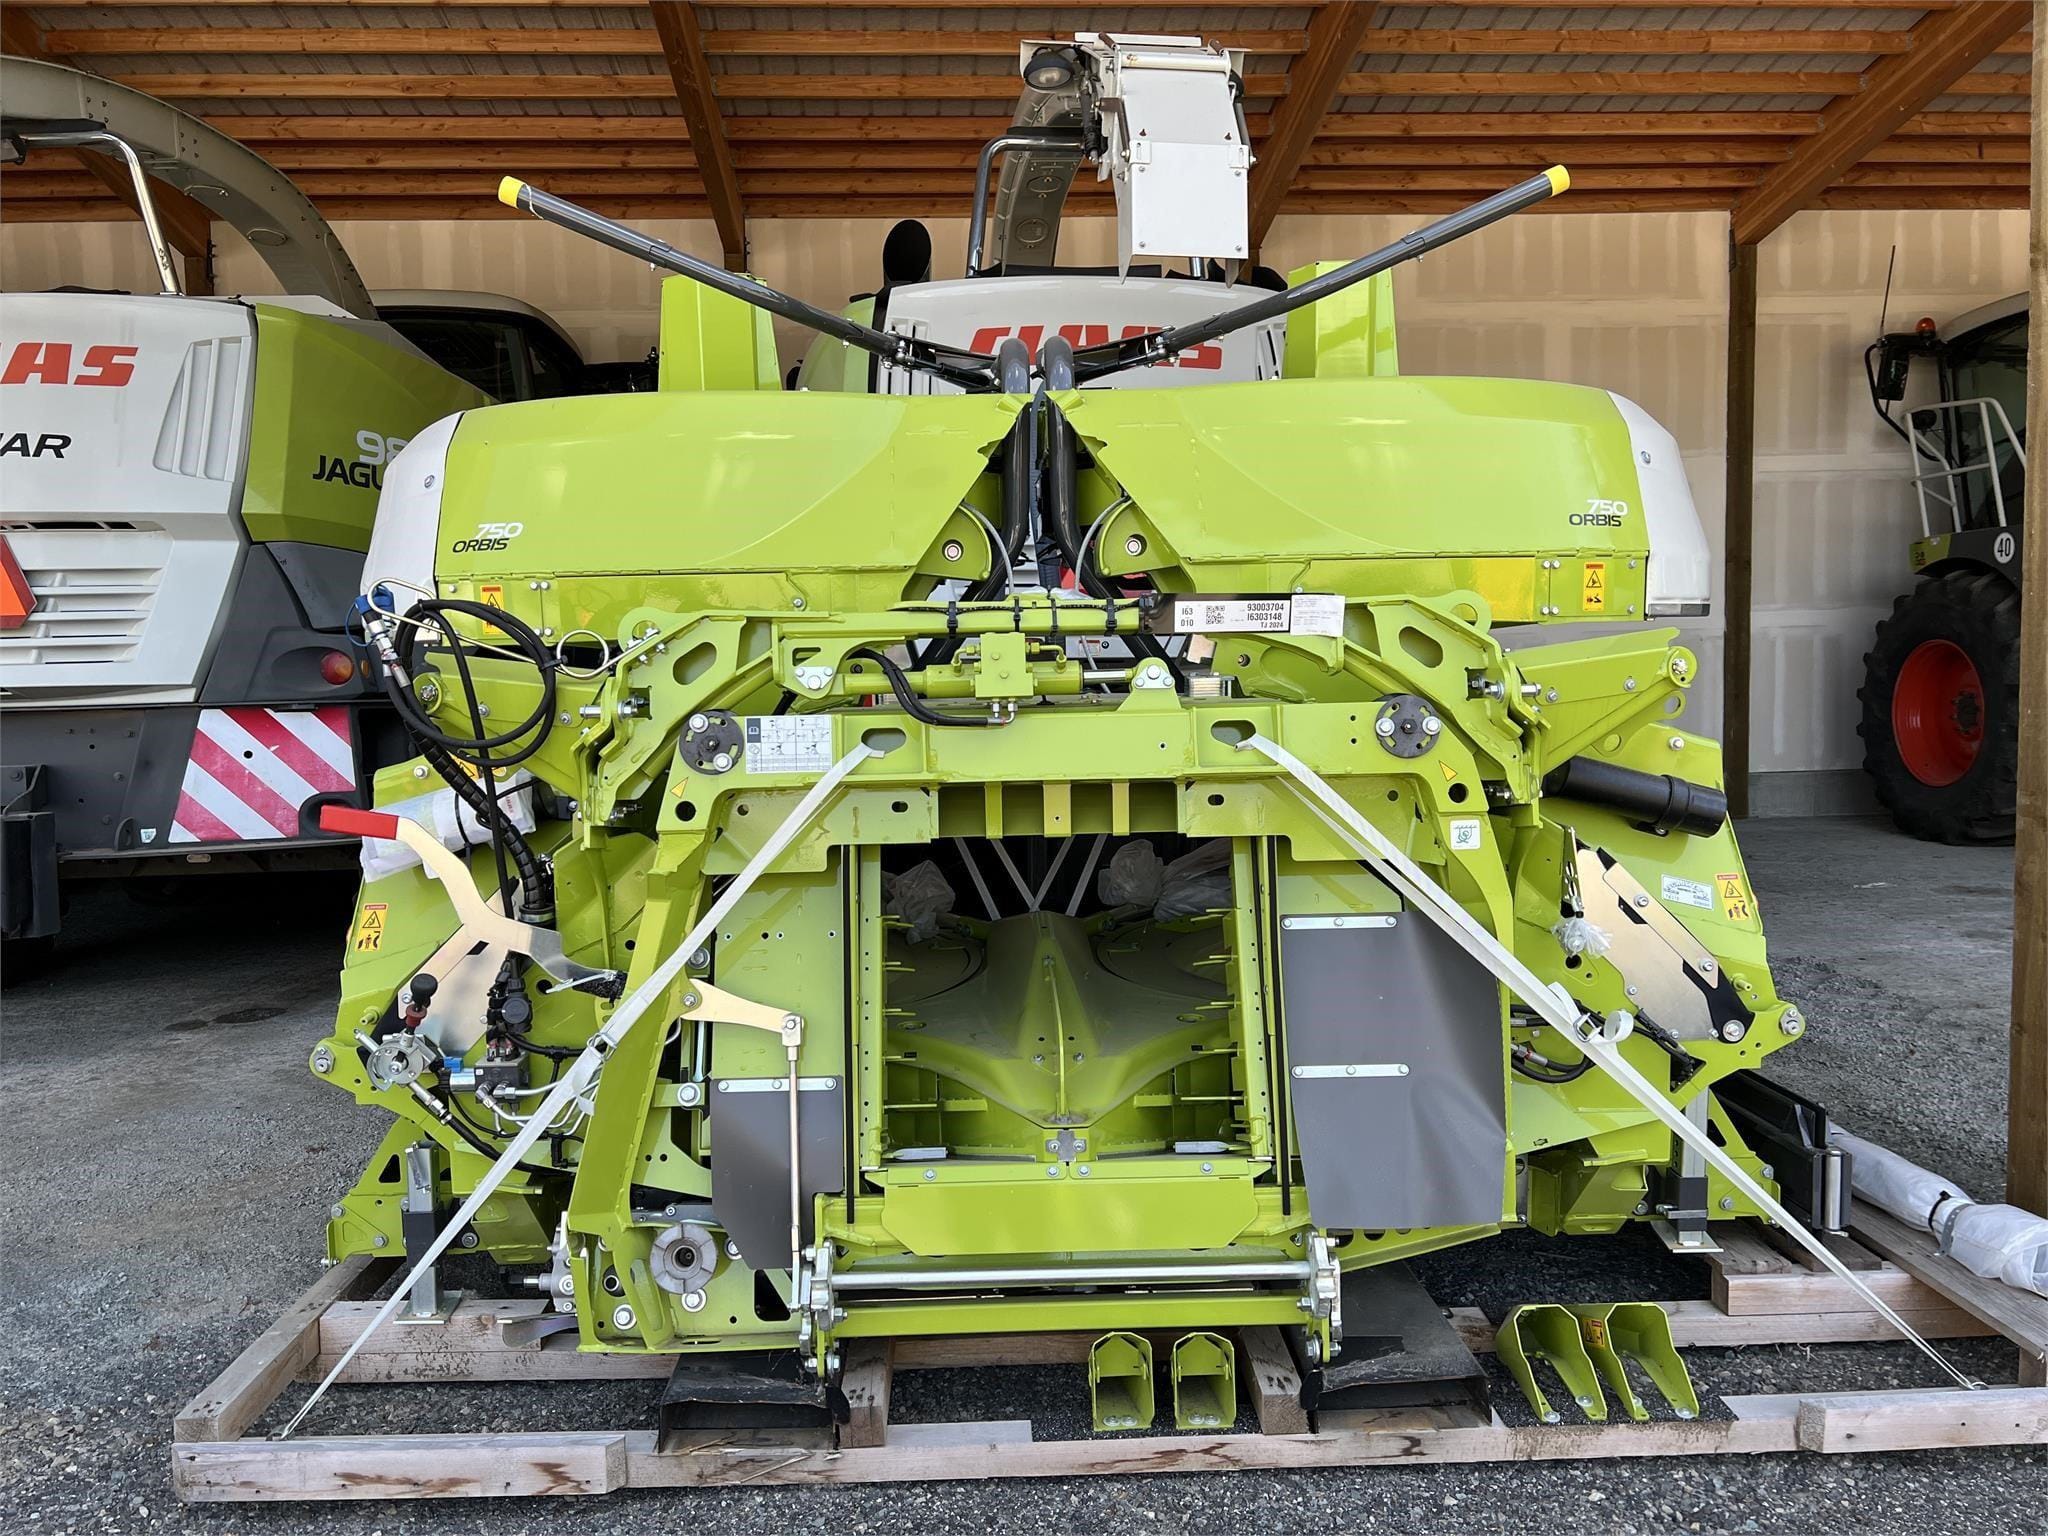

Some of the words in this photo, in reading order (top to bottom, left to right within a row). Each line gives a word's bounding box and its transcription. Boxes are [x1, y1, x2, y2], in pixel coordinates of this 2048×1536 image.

[0, 432, 72, 459] AR
[1586, 499, 1628, 516] 750
[1569, 513, 1622, 527] ORBIS
[476, 522, 523, 539] 750
[452, 538, 510, 553] ORBIS
[1997, 537, 2011, 557] 40
[1247, 603, 1284, 612] 93003704
